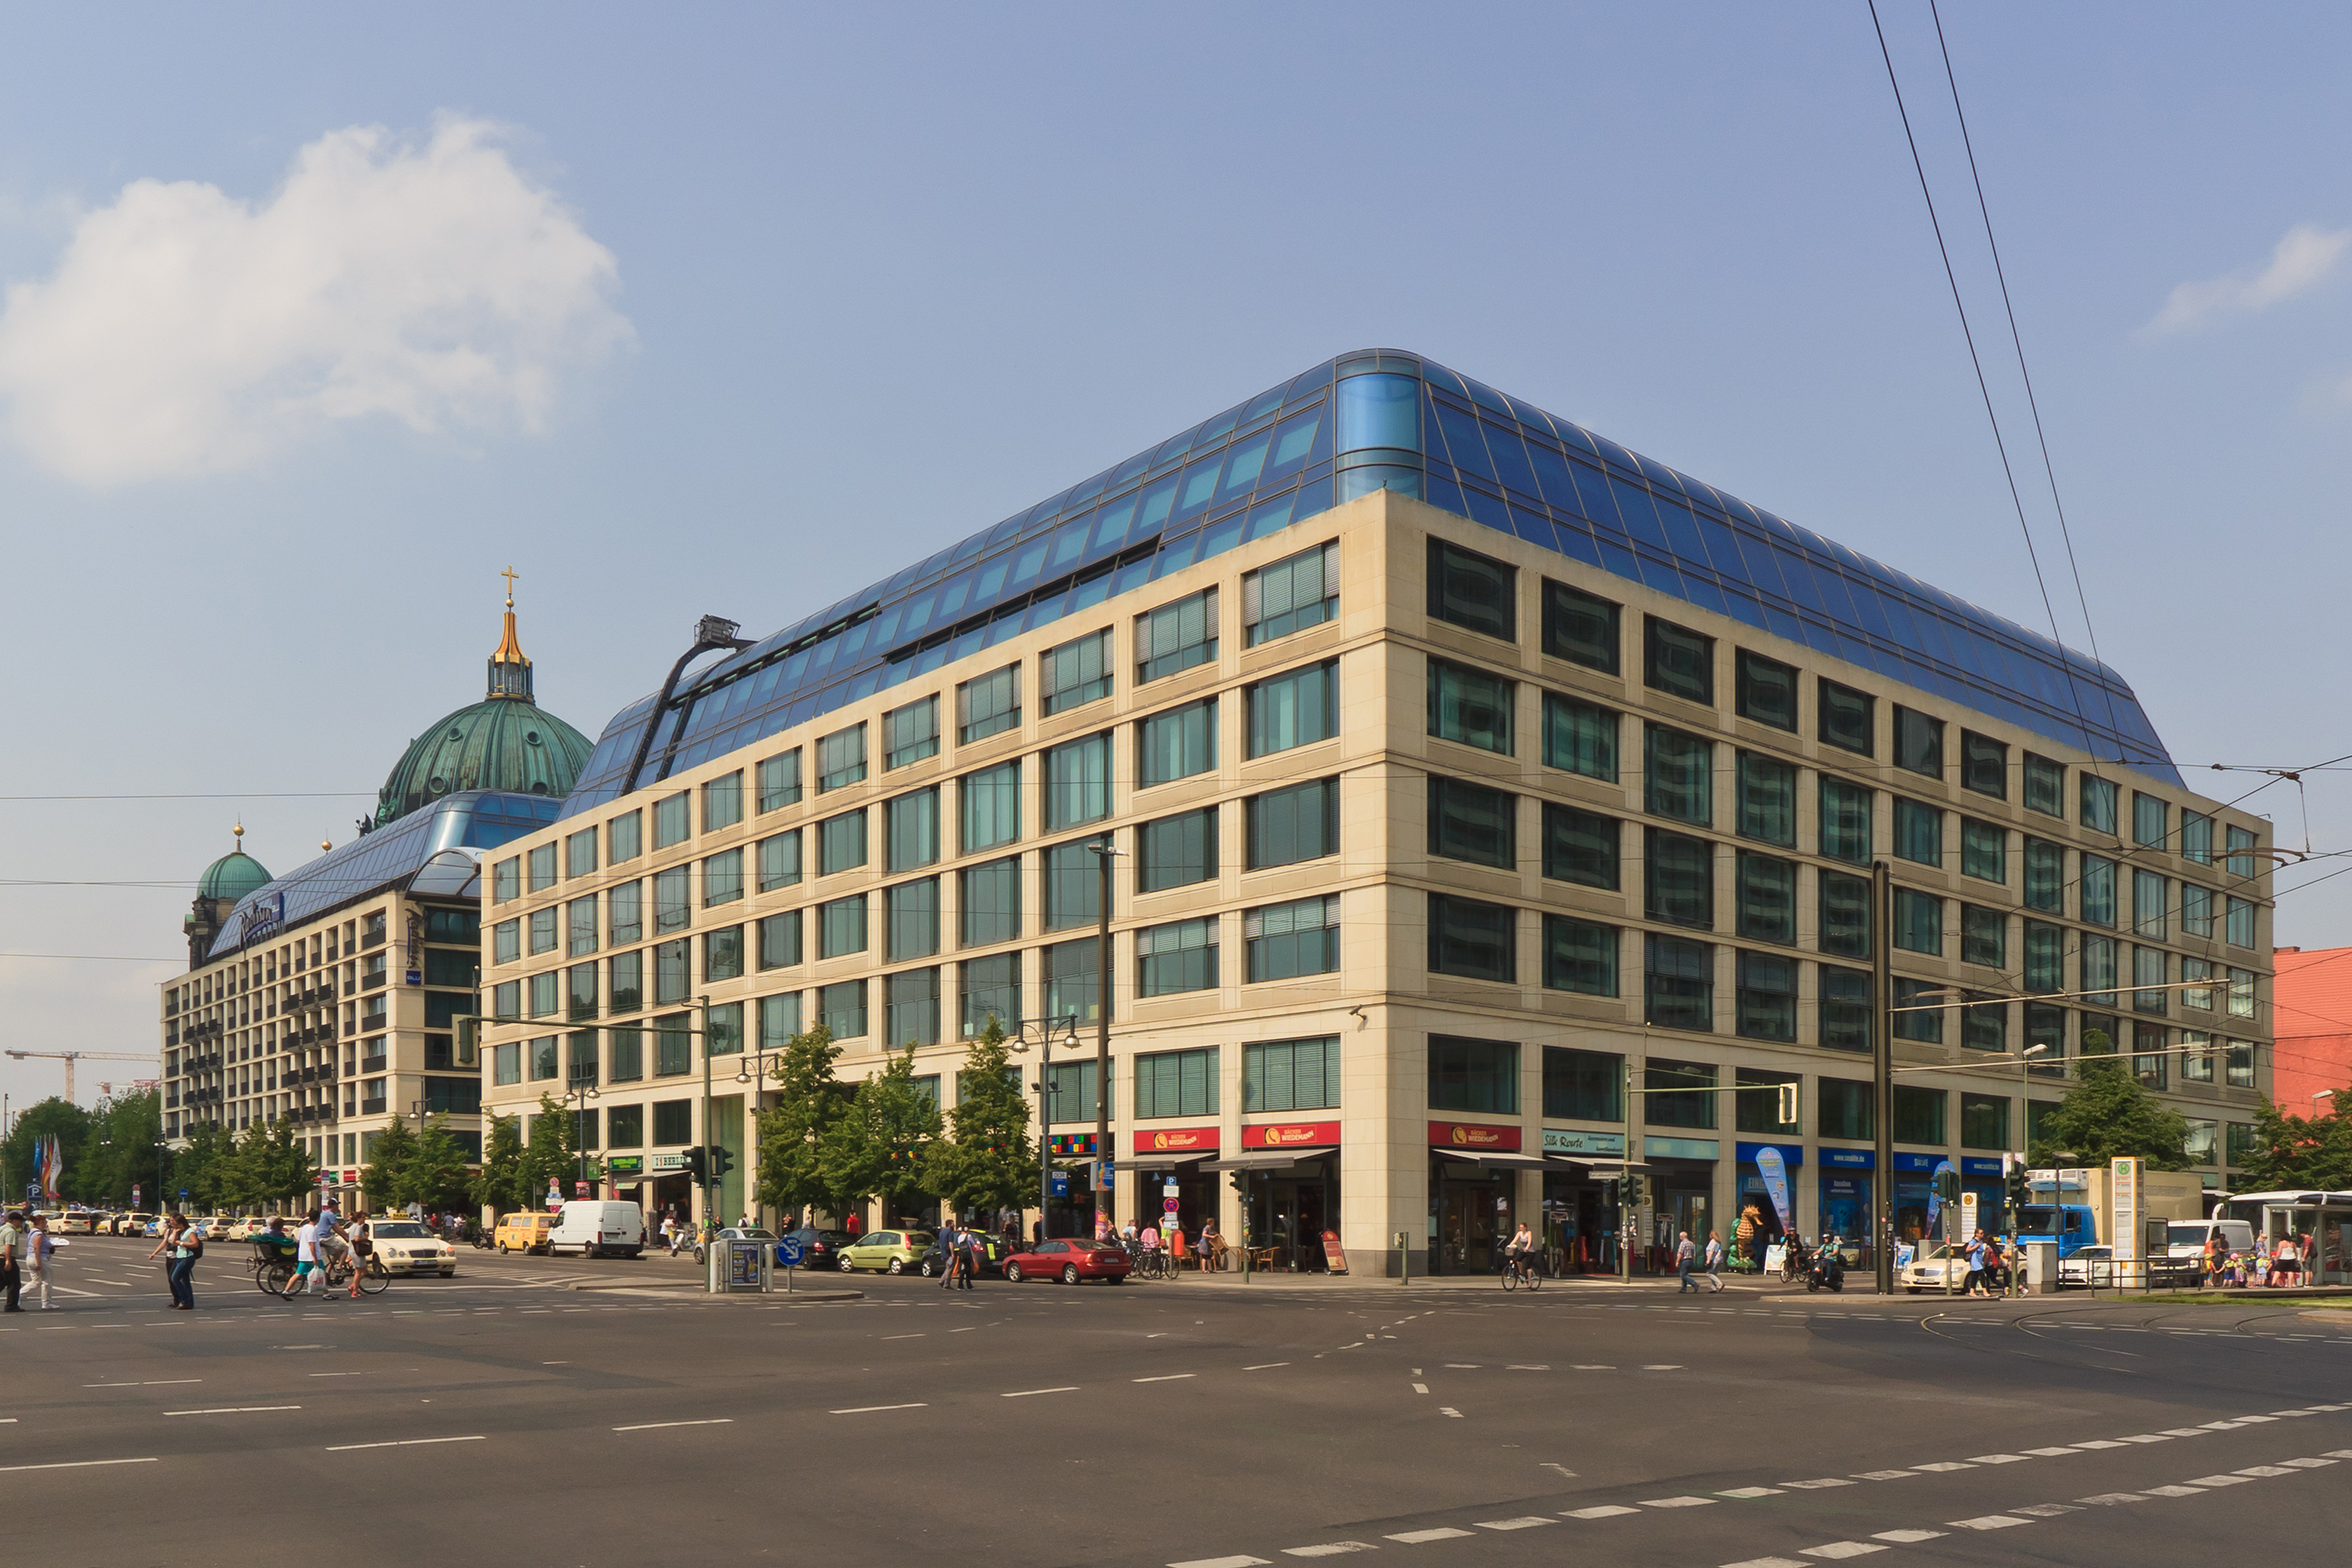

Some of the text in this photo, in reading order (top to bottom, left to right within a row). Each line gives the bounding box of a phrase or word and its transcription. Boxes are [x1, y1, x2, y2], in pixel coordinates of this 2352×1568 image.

[1544, 1135, 1557, 1146] Silk
[1560, 1136, 1583, 1148] Route
[32, 1188, 39, 1197] P
